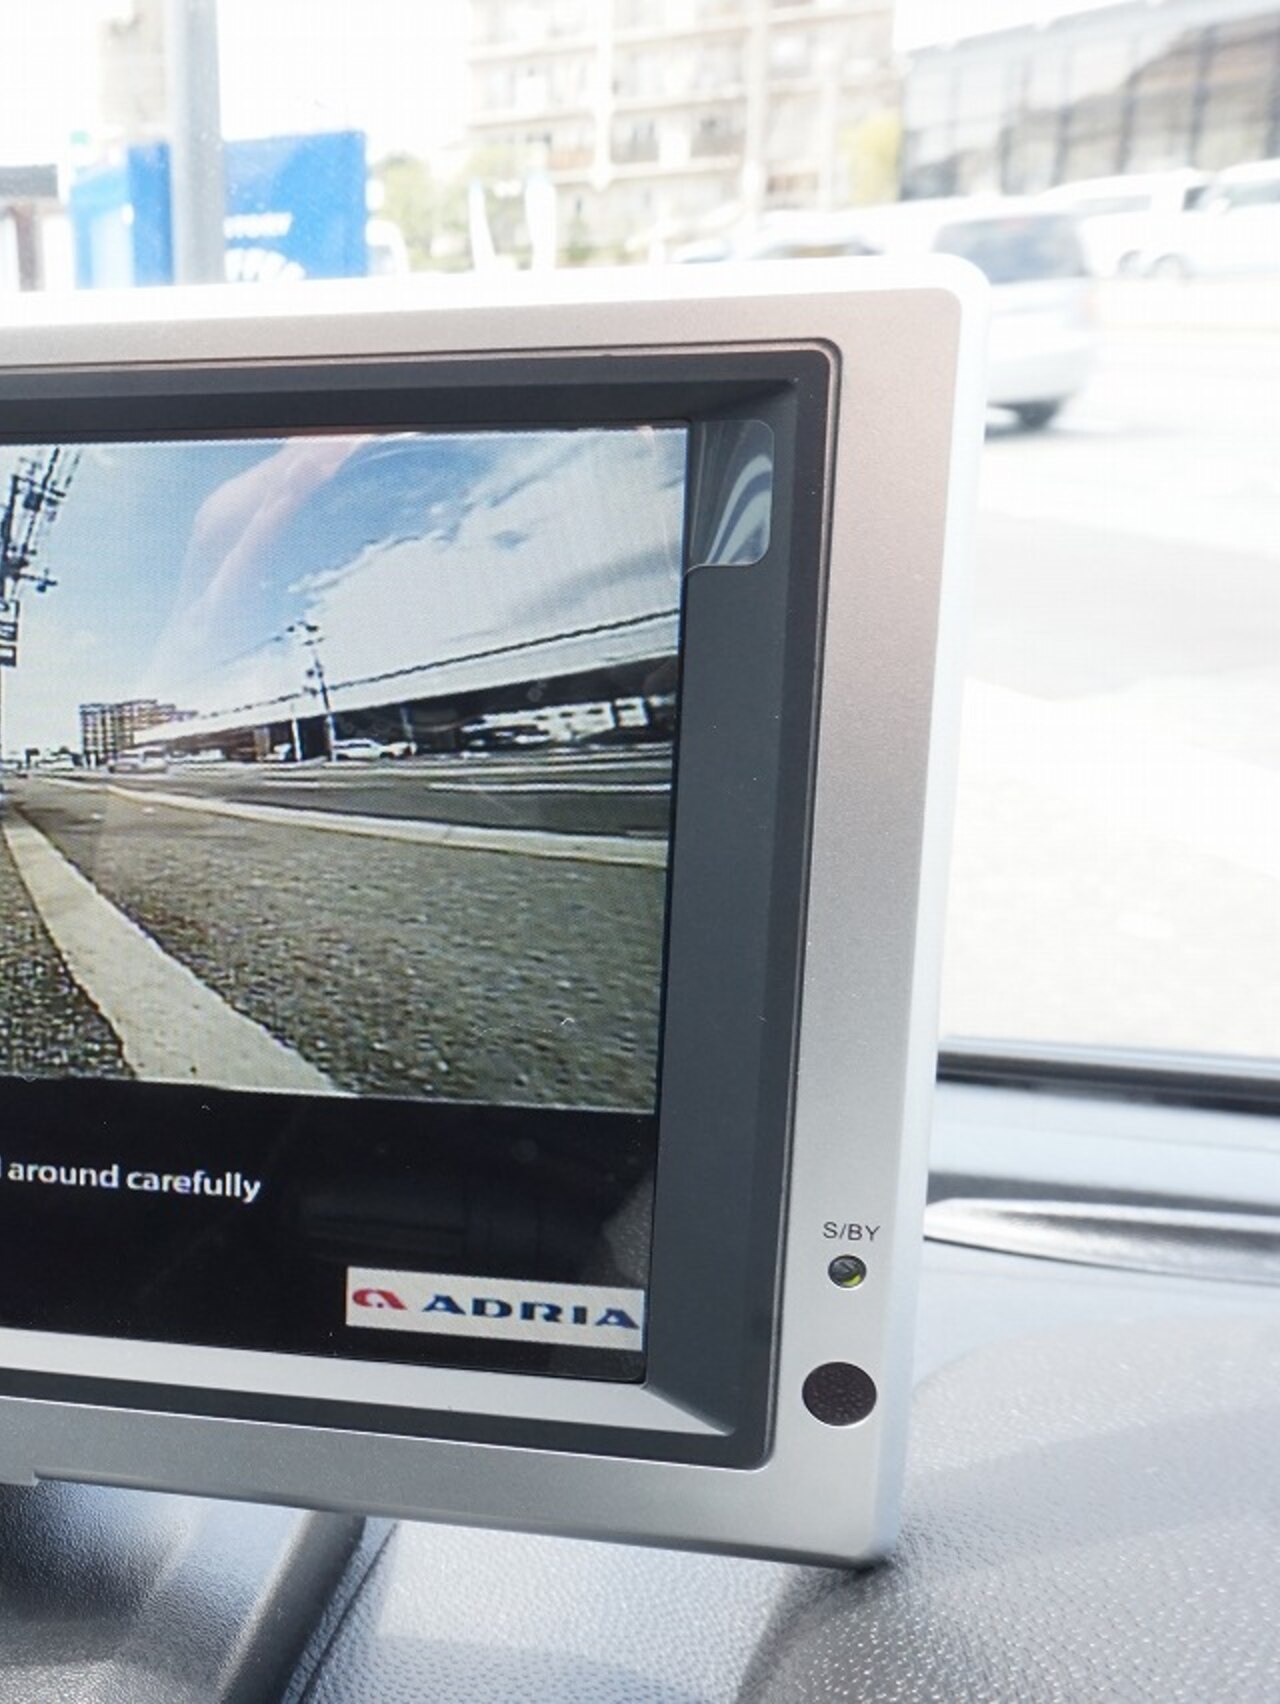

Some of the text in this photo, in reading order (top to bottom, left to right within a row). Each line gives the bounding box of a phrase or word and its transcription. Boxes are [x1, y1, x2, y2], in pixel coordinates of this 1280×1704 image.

[7, 1162, 119, 1190] around
[126, 1169, 262, 1203] carefully
[822, 1220, 881, 1243] S/BY
[422, 1293, 641, 1331] ADRIA
